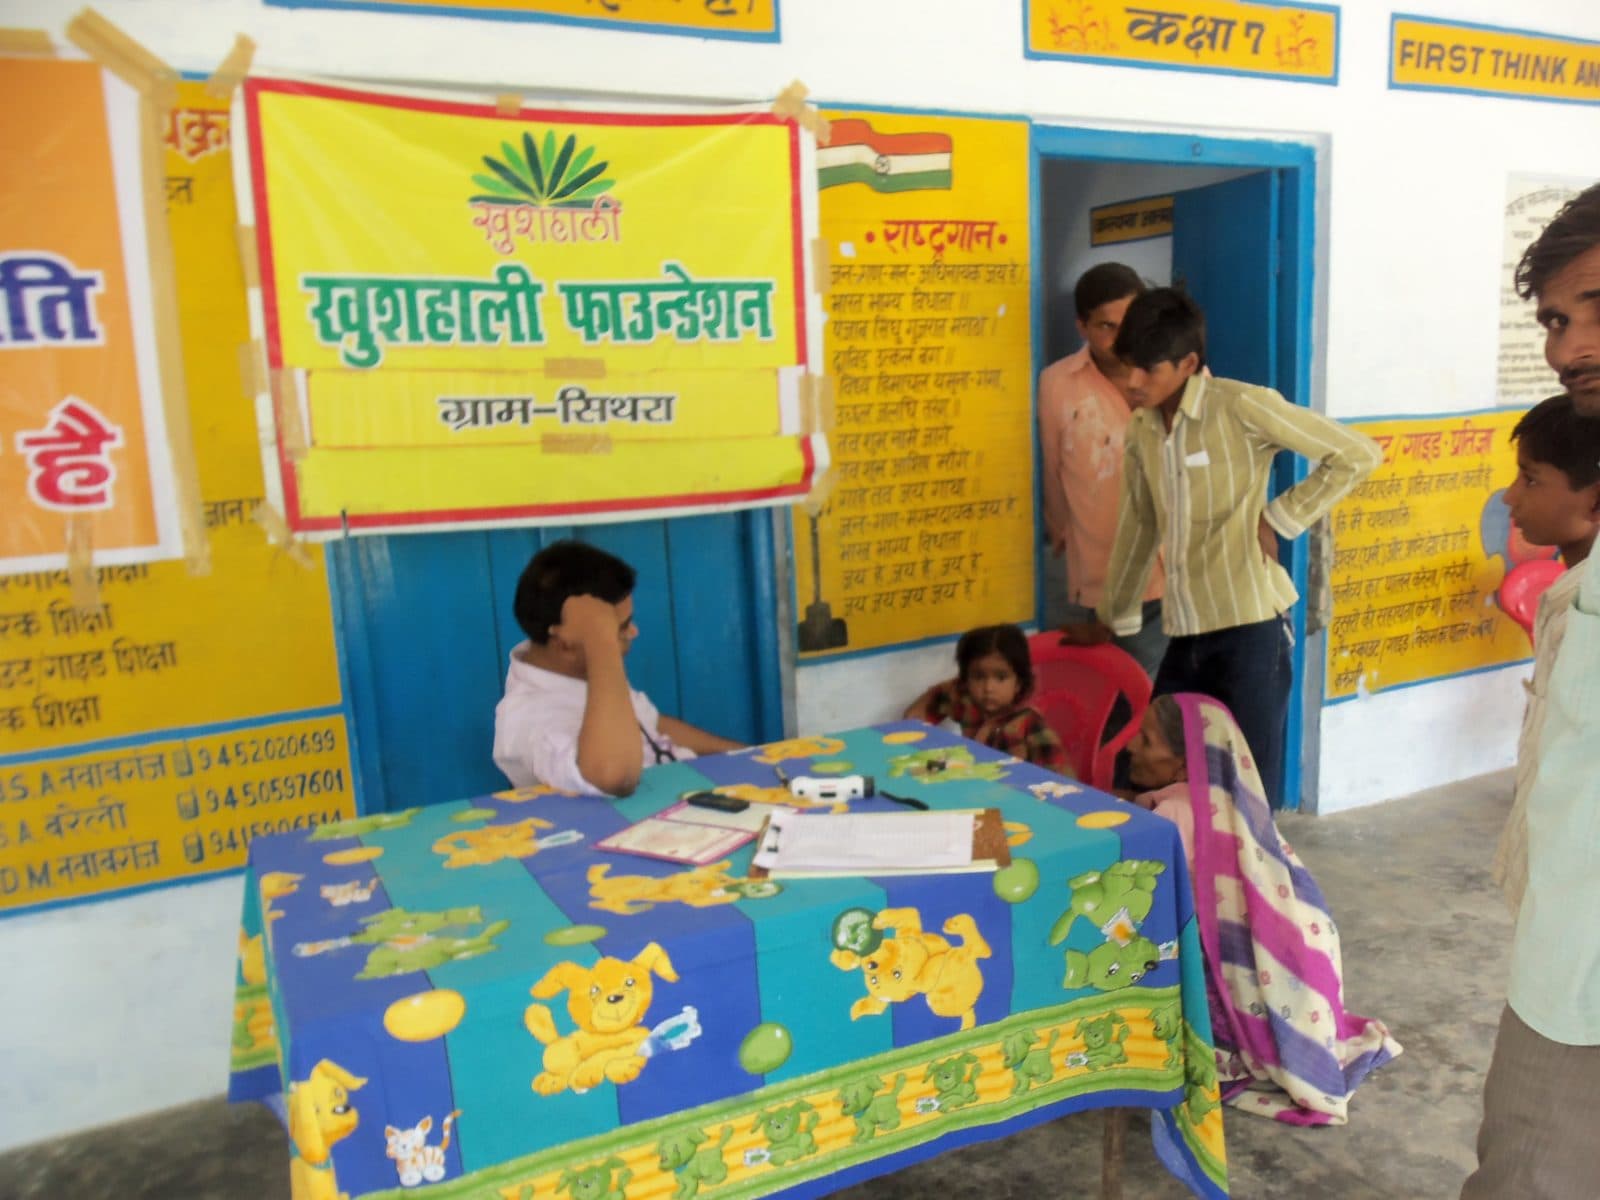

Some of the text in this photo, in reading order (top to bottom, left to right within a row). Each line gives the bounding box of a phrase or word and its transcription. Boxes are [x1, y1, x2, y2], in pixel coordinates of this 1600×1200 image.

[1125, 8, 1265, 58] कक्षा 7
[1400, 39, 1485, 75] FIRST
[1491, 49, 1567, 85] THINK
[471, 195, 622, 254] खुशहाली
[882, 220, 998, 258] राष्ट्रगान
[0, 258, 97, 342] ति
[303, 263, 774, 367] खुशहाली फाउन्डेशन
[23, 402, 117, 505] है
[112, 637, 177, 674] शिक्षा
[0, 693, 100, 732] क शिक्षा
[198, 729, 336, 771] 9452020699
[206, 768, 344, 812] 9450597601
